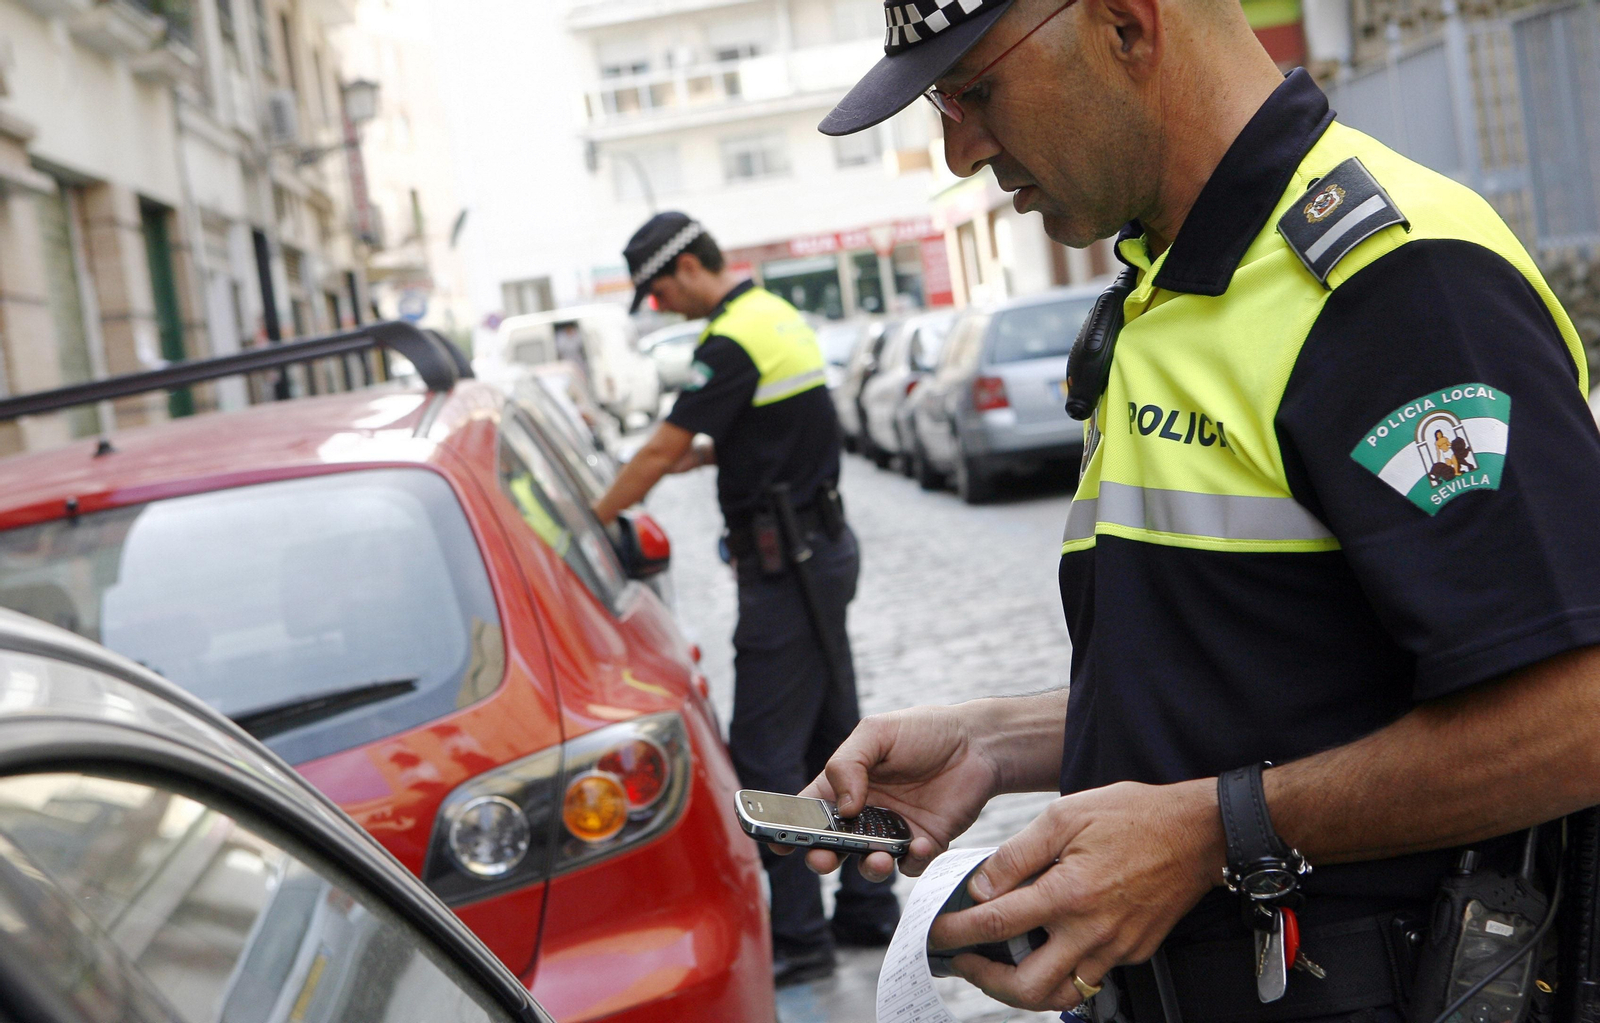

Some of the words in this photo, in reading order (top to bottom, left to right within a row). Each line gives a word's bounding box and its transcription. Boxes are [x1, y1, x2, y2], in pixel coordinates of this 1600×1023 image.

[1127, 401, 1236, 455] POLICI
[1366, 398, 1436, 447] POLICIA
[1442, 386, 1496, 404] LOCAL
[1430, 474, 1491, 505] SEVILLA
